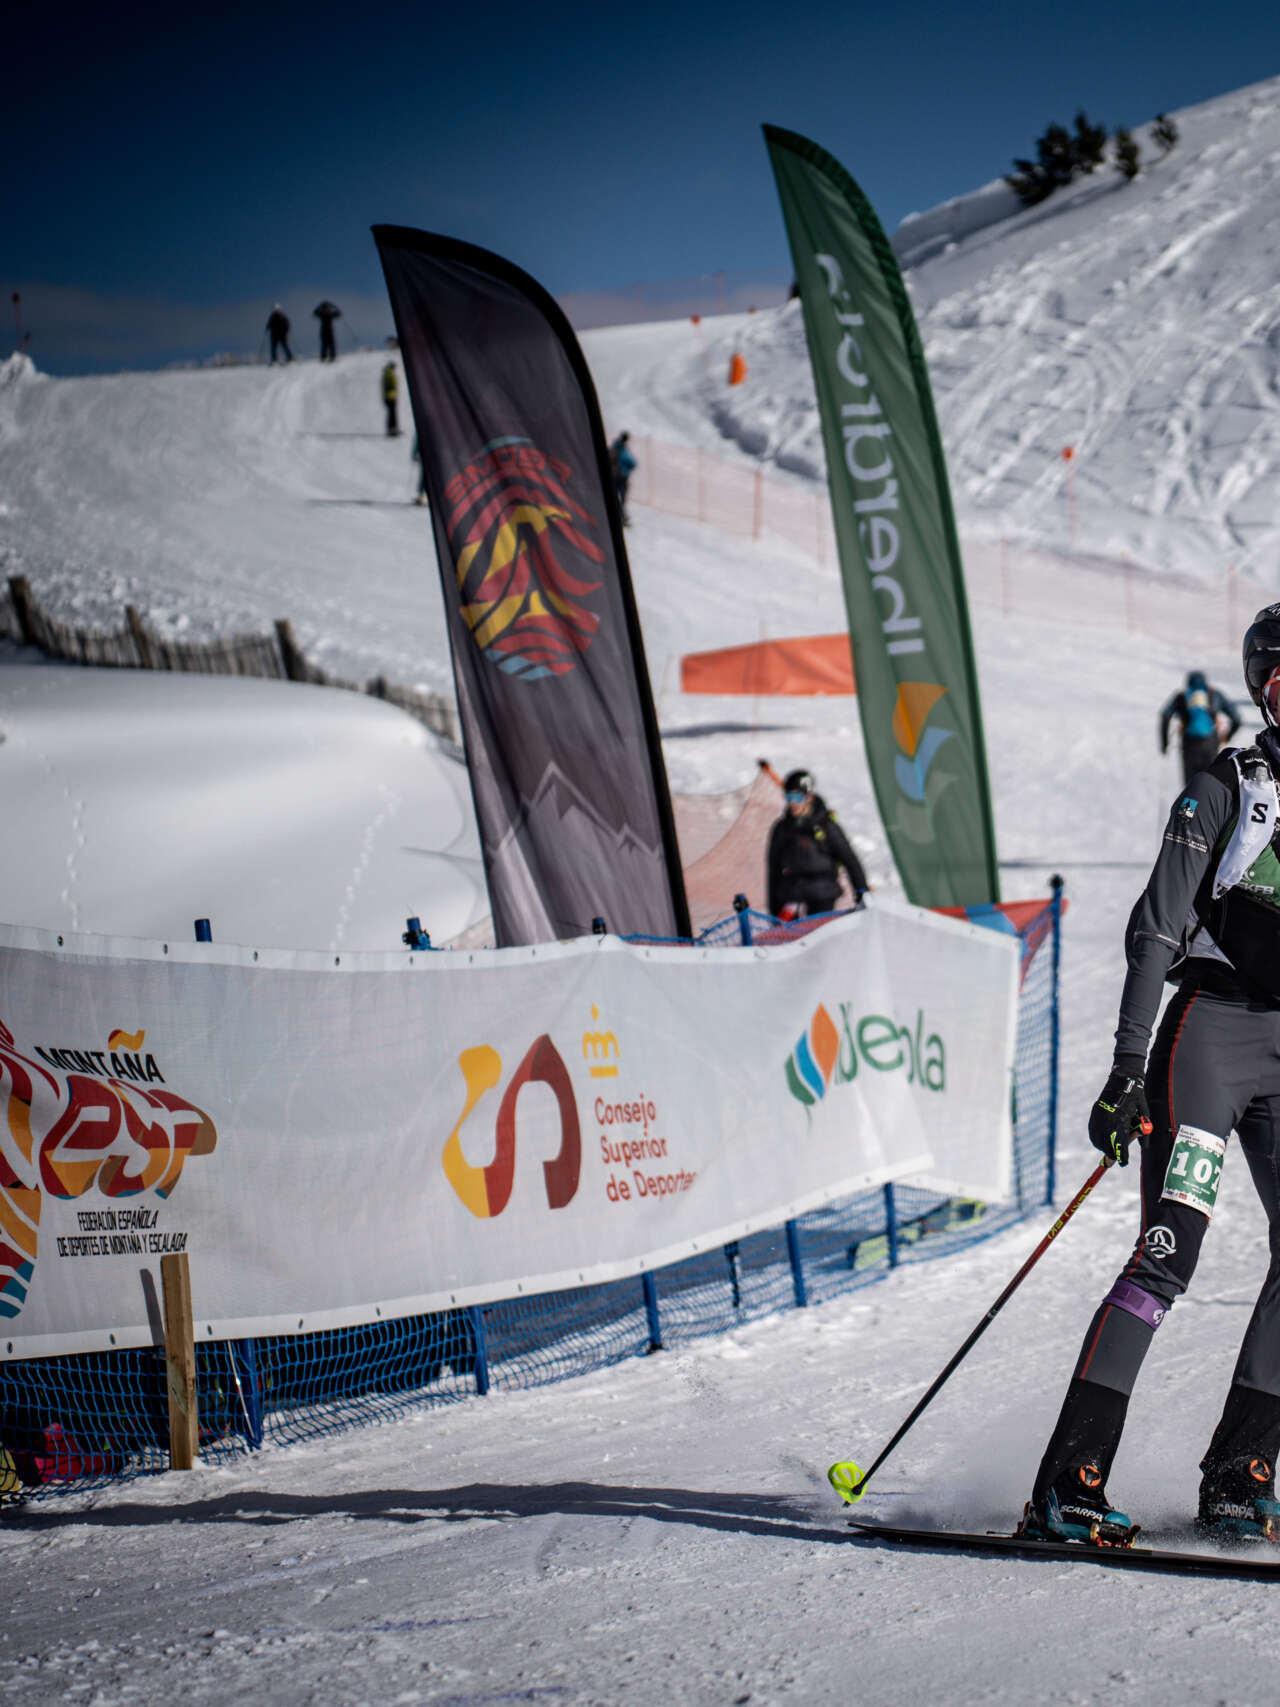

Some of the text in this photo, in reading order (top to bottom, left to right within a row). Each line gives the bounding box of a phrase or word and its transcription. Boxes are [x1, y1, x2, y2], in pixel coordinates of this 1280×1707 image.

[594, 1093, 656, 1128] Consejo
[601, 1131, 668, 1168] Superior
[606, 1173, 631, 1202] de
[77, 1205, 159, 1231] FEDERACIÓN ESPAÑOLA
[57, 1237, 69, 1257] DE
[68, 1236, 100, 1256] DEPORTES
[100, 1235, 110, 1255] DE
[109, 1230, 143, 1254] MONTAÑA
[149, 1232, 188, 1253] ESCALADA
[1060, 1504, 1103, 1521] SCARPA
